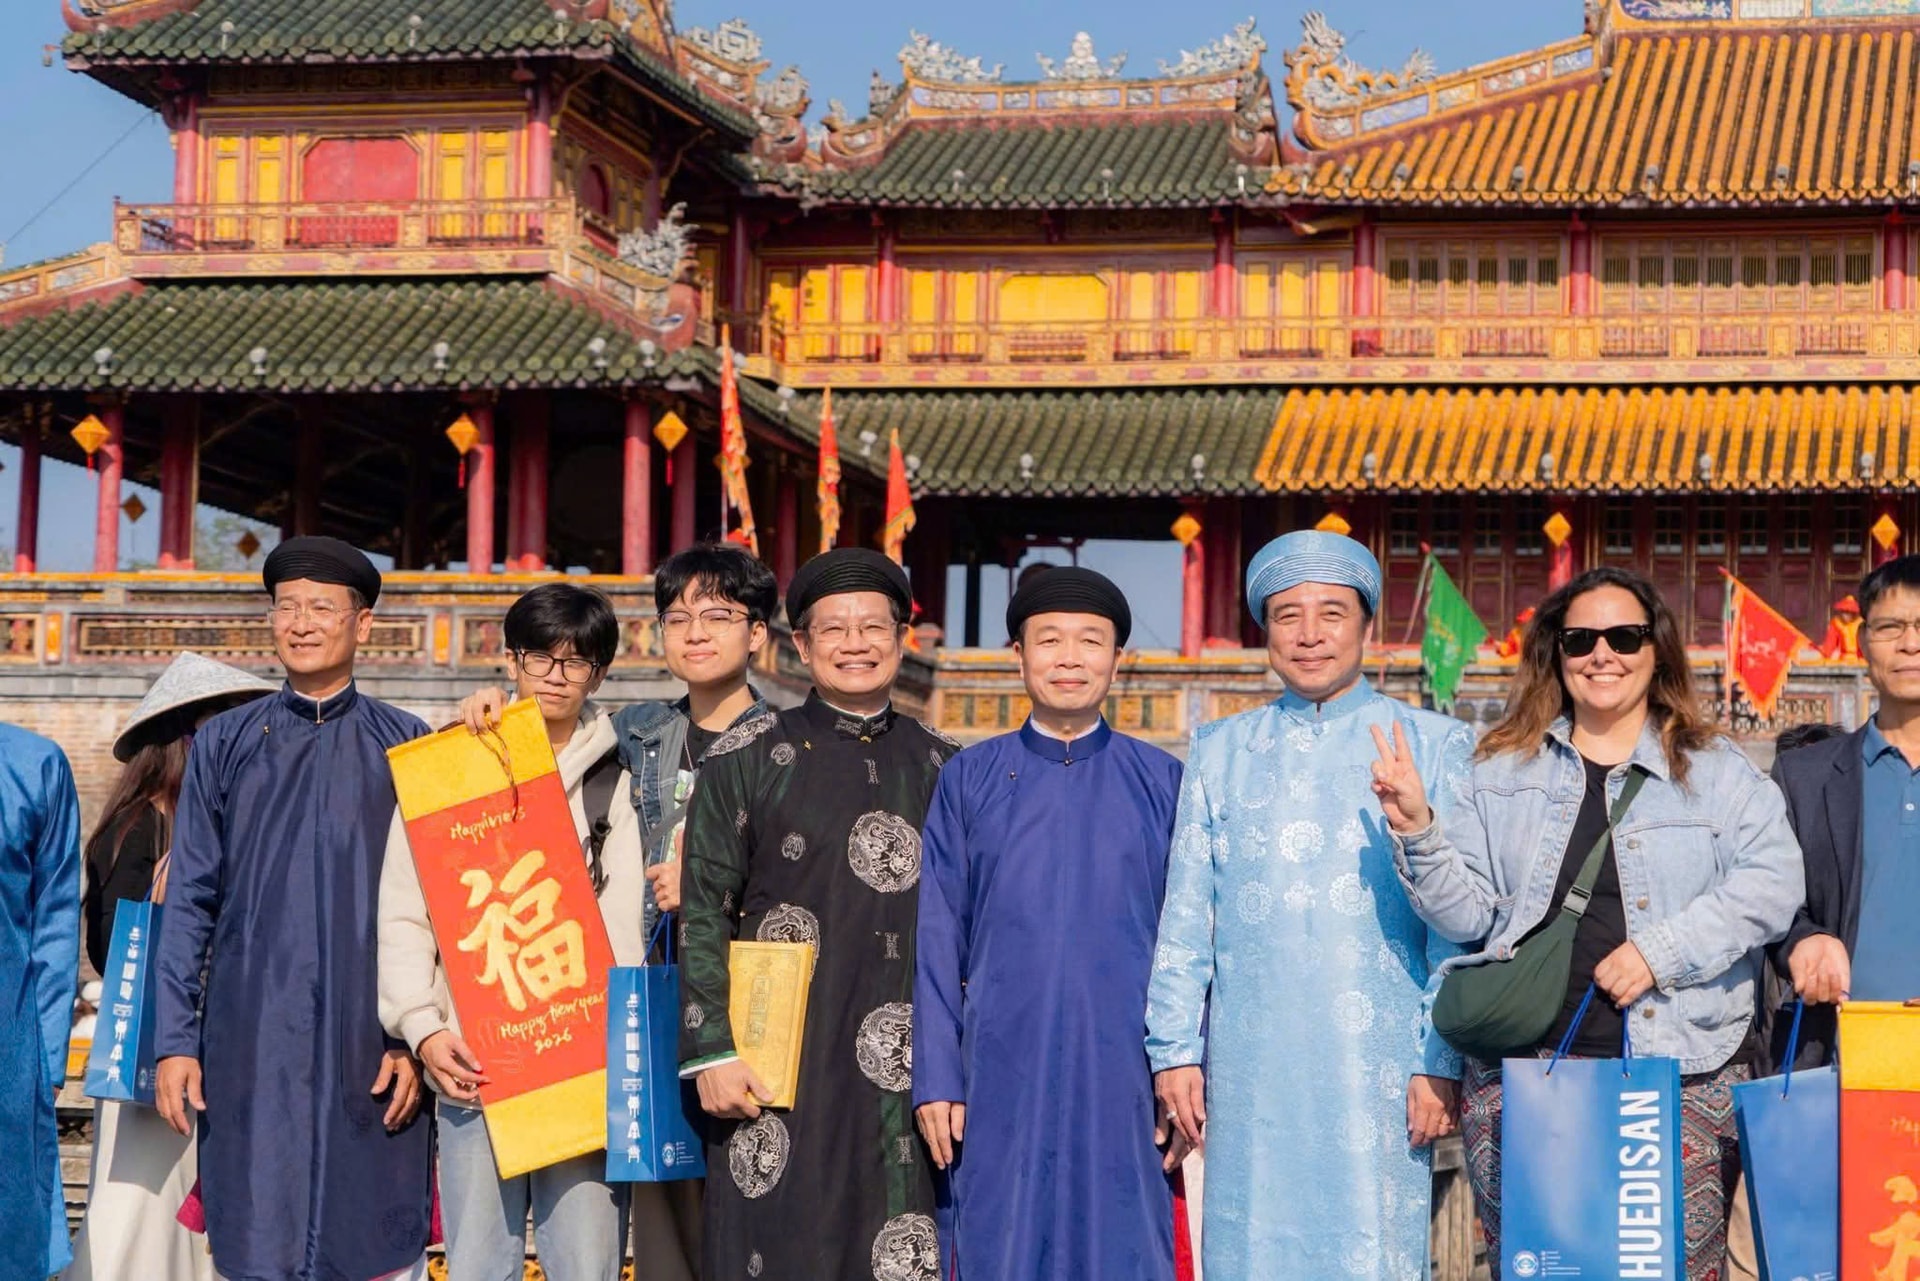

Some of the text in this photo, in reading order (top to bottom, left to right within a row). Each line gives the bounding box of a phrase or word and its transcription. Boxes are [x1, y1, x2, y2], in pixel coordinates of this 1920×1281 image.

[456, 849, 588, 1012] 福
[500, 1012, 549, 1041] Happy
[534, 1026, 573, 1055] 2026
[1618, 1090, 1663, 1278] HUEDISAN
